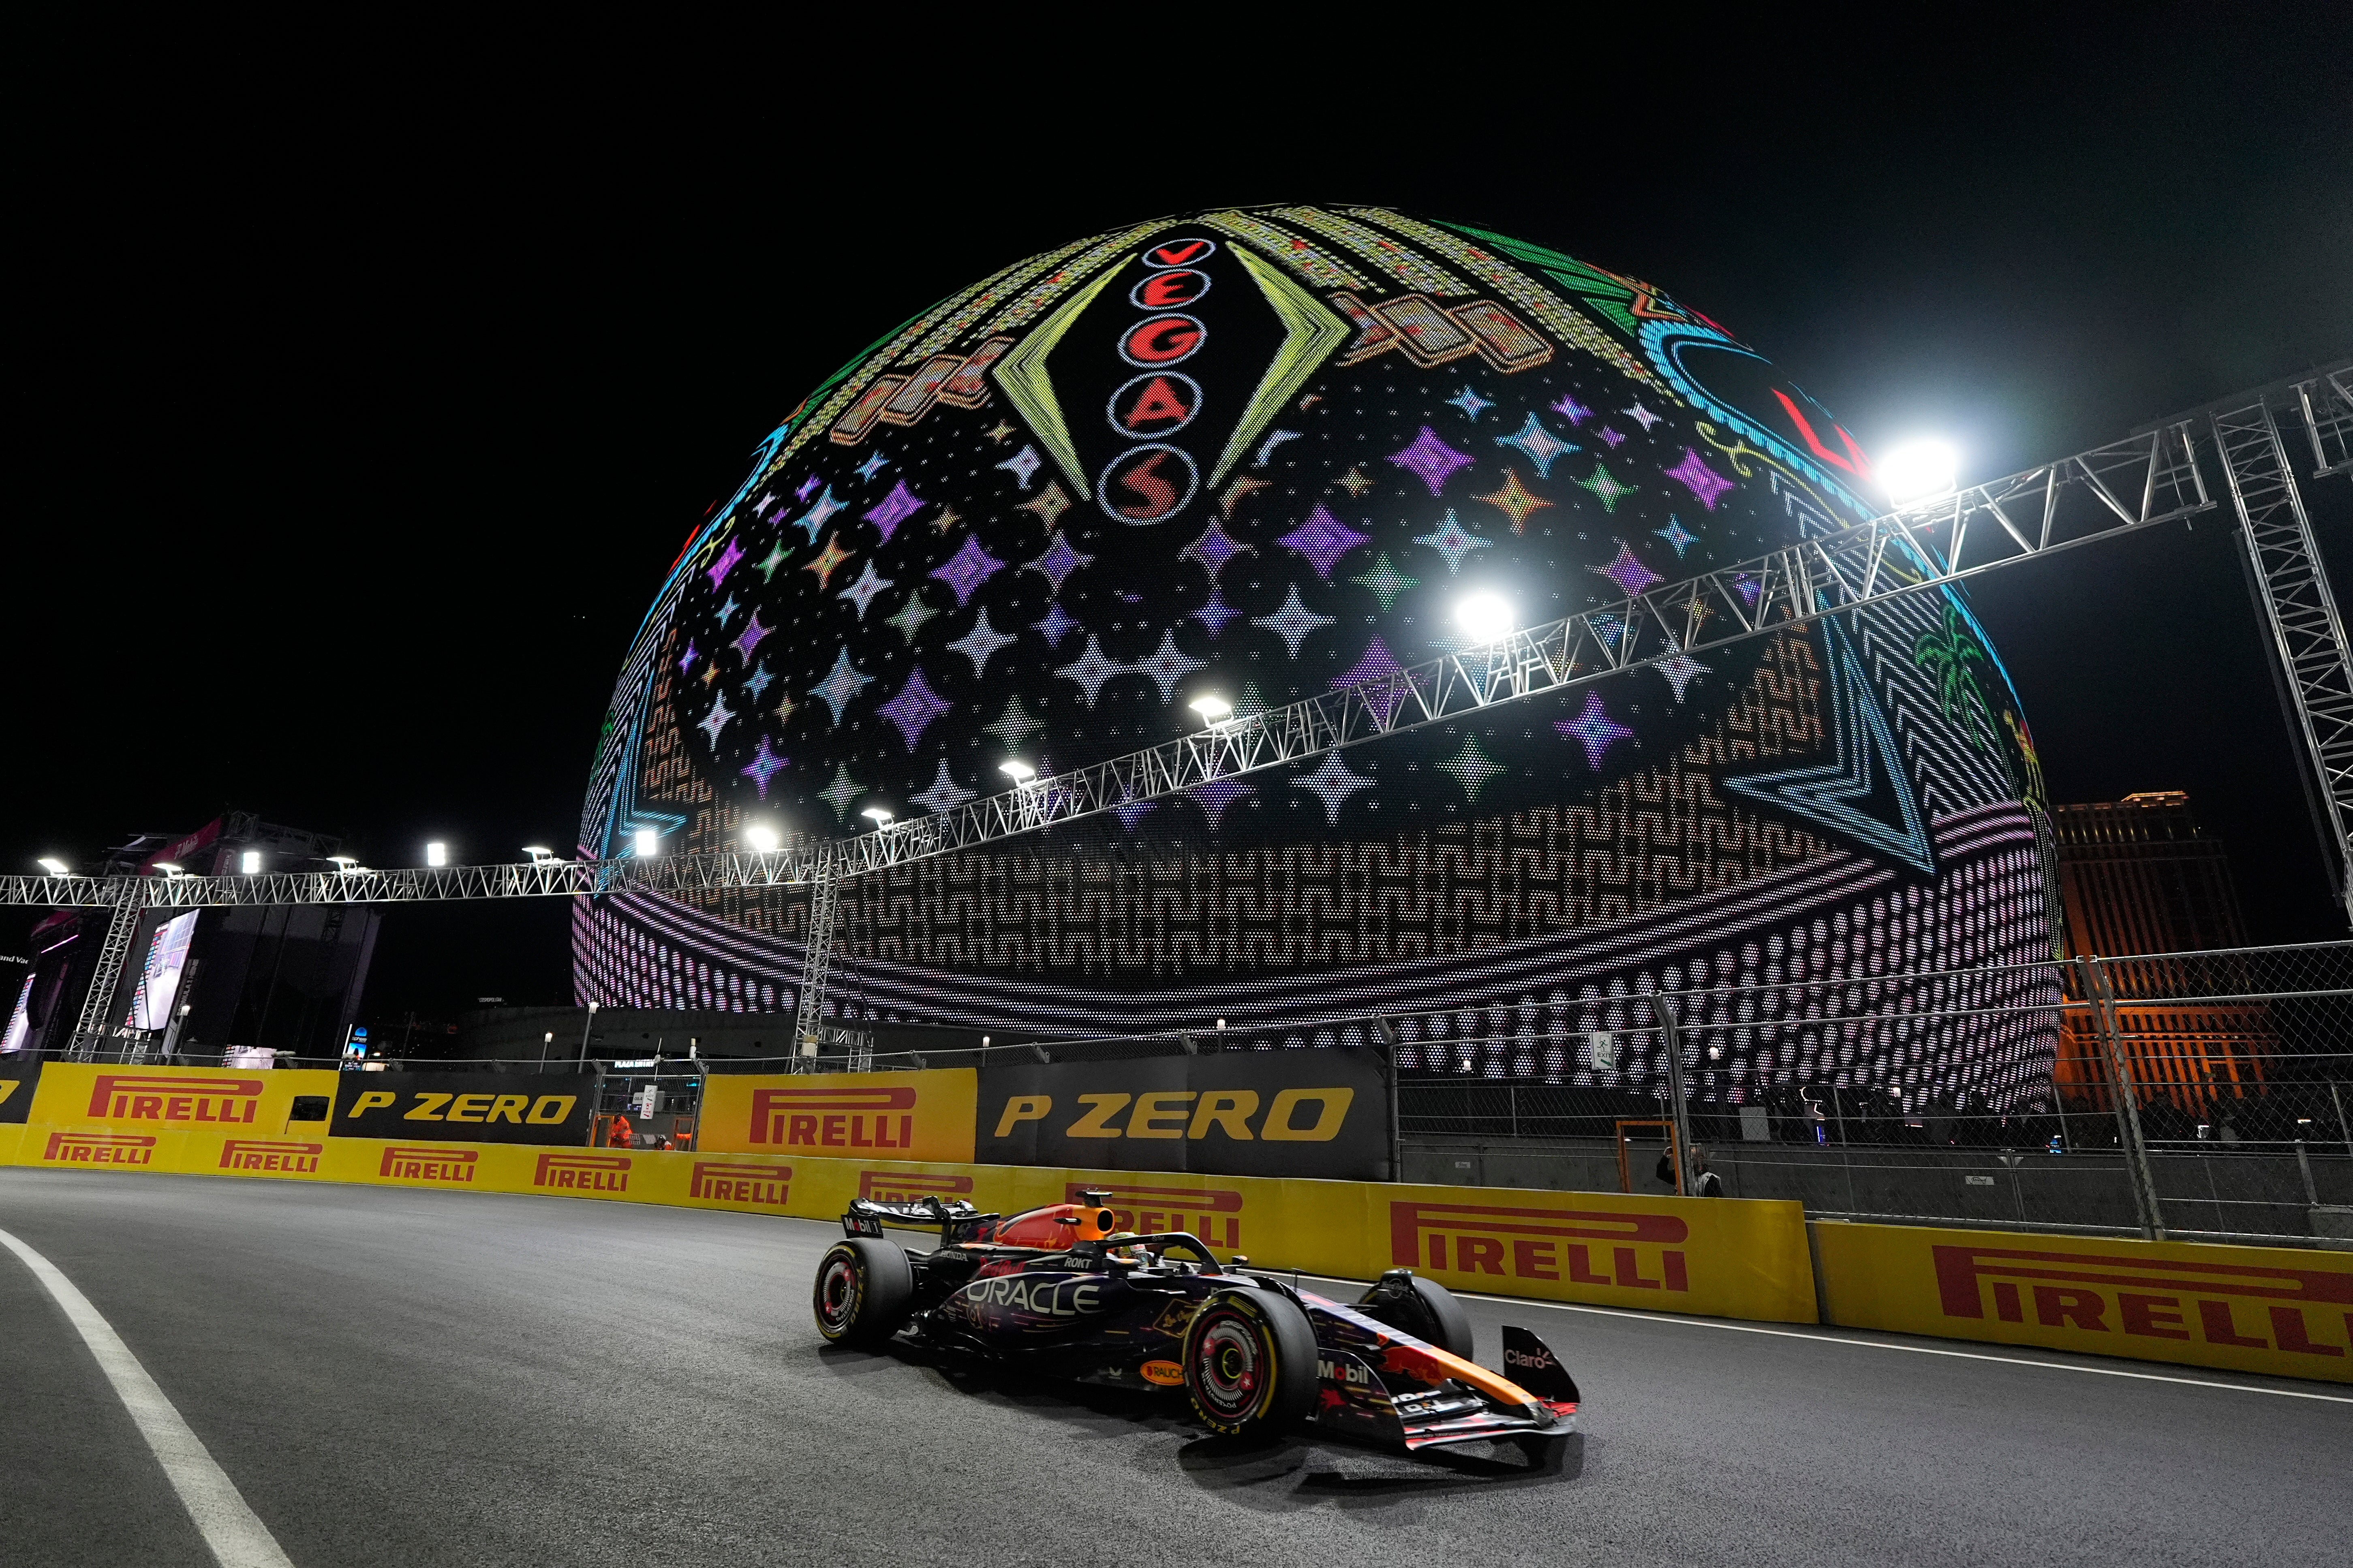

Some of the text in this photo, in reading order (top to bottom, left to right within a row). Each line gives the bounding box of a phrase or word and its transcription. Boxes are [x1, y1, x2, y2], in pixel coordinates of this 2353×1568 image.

[1118, 241, 1206, 519] VEGAS
[88, 1075, 263, 1123] PIRELLI
[348, 1091, 577, 1124] P ZERO
[995, 1087, 1354, 1141] P ZERO
[749, 1087, 916, 1148] PIRELLI
[44, 1133, 156, 1164] PIRELLI
[219, 1140, 323, 1173] PIRELLI
[379, 1147, 479, 1182] PIRELLI
[534, 1154, 632, 1192] PIRELLI
[690, 1162, 793, 1205] PIRELLI
[844, 1217, 879, 1233] Mobil 1
[939, 1250, 969, 1262] HONDA
[1064, 1257, 1093, 1269] ROKT
[1390, 1201, 1688, 1292] PIRELLI
[967, 1279, 1100, 1316] ORACLE
[1318, 1359, 1369, 1384] Mobil
[1505, 1350, 1545, 1369] Claro
[1190, 1397, 1227, 1434] ZERO
